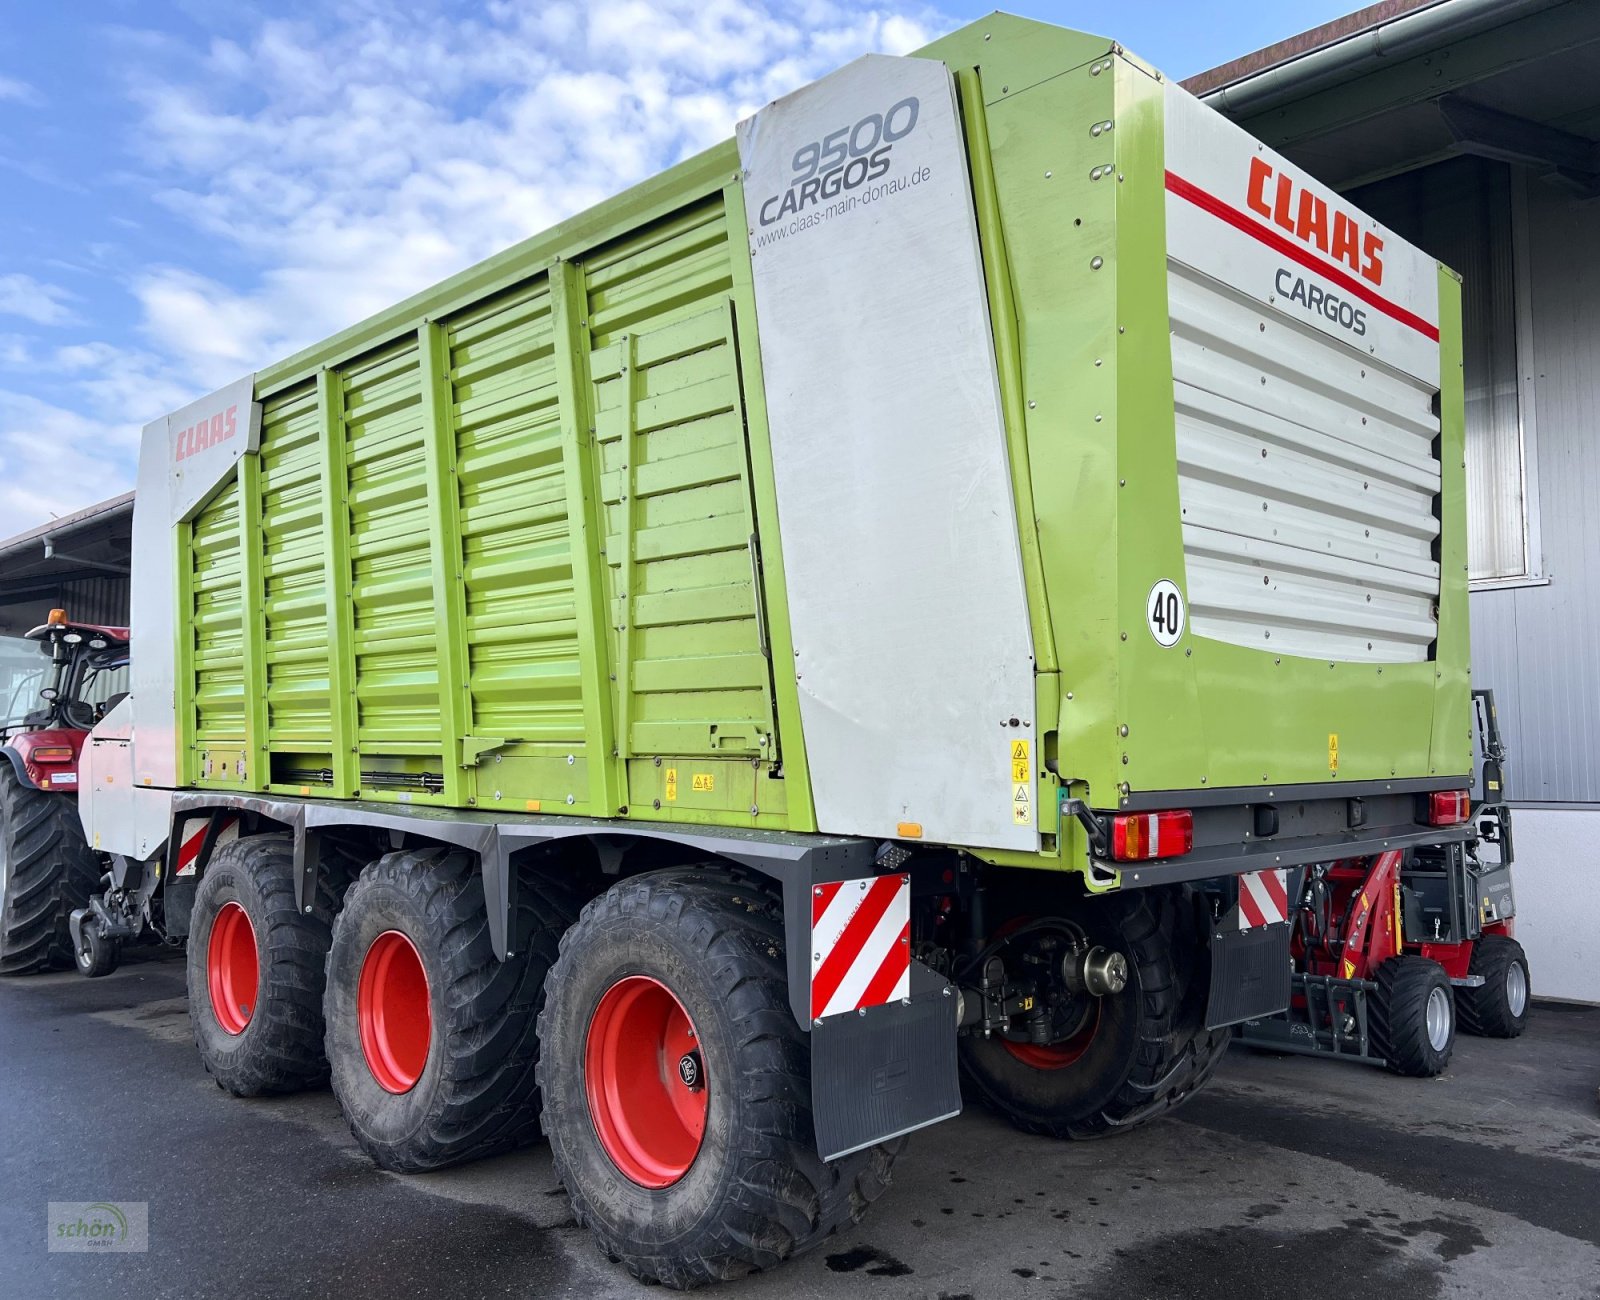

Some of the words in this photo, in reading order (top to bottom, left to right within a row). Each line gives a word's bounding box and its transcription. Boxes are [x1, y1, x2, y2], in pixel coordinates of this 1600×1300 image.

[790, 96, 920, 187] 9500
[757, 165, 931, 248] www.claas-main-donau.de
[759, 144, 892, 227] CARGOS
[1247, 156, 1384, 286] CLAAS
[1275, 268, 1366, 336] CARGOS
[176, 404, 237, 462] CLAAS
[1153, 592, 1178, 635] 40
